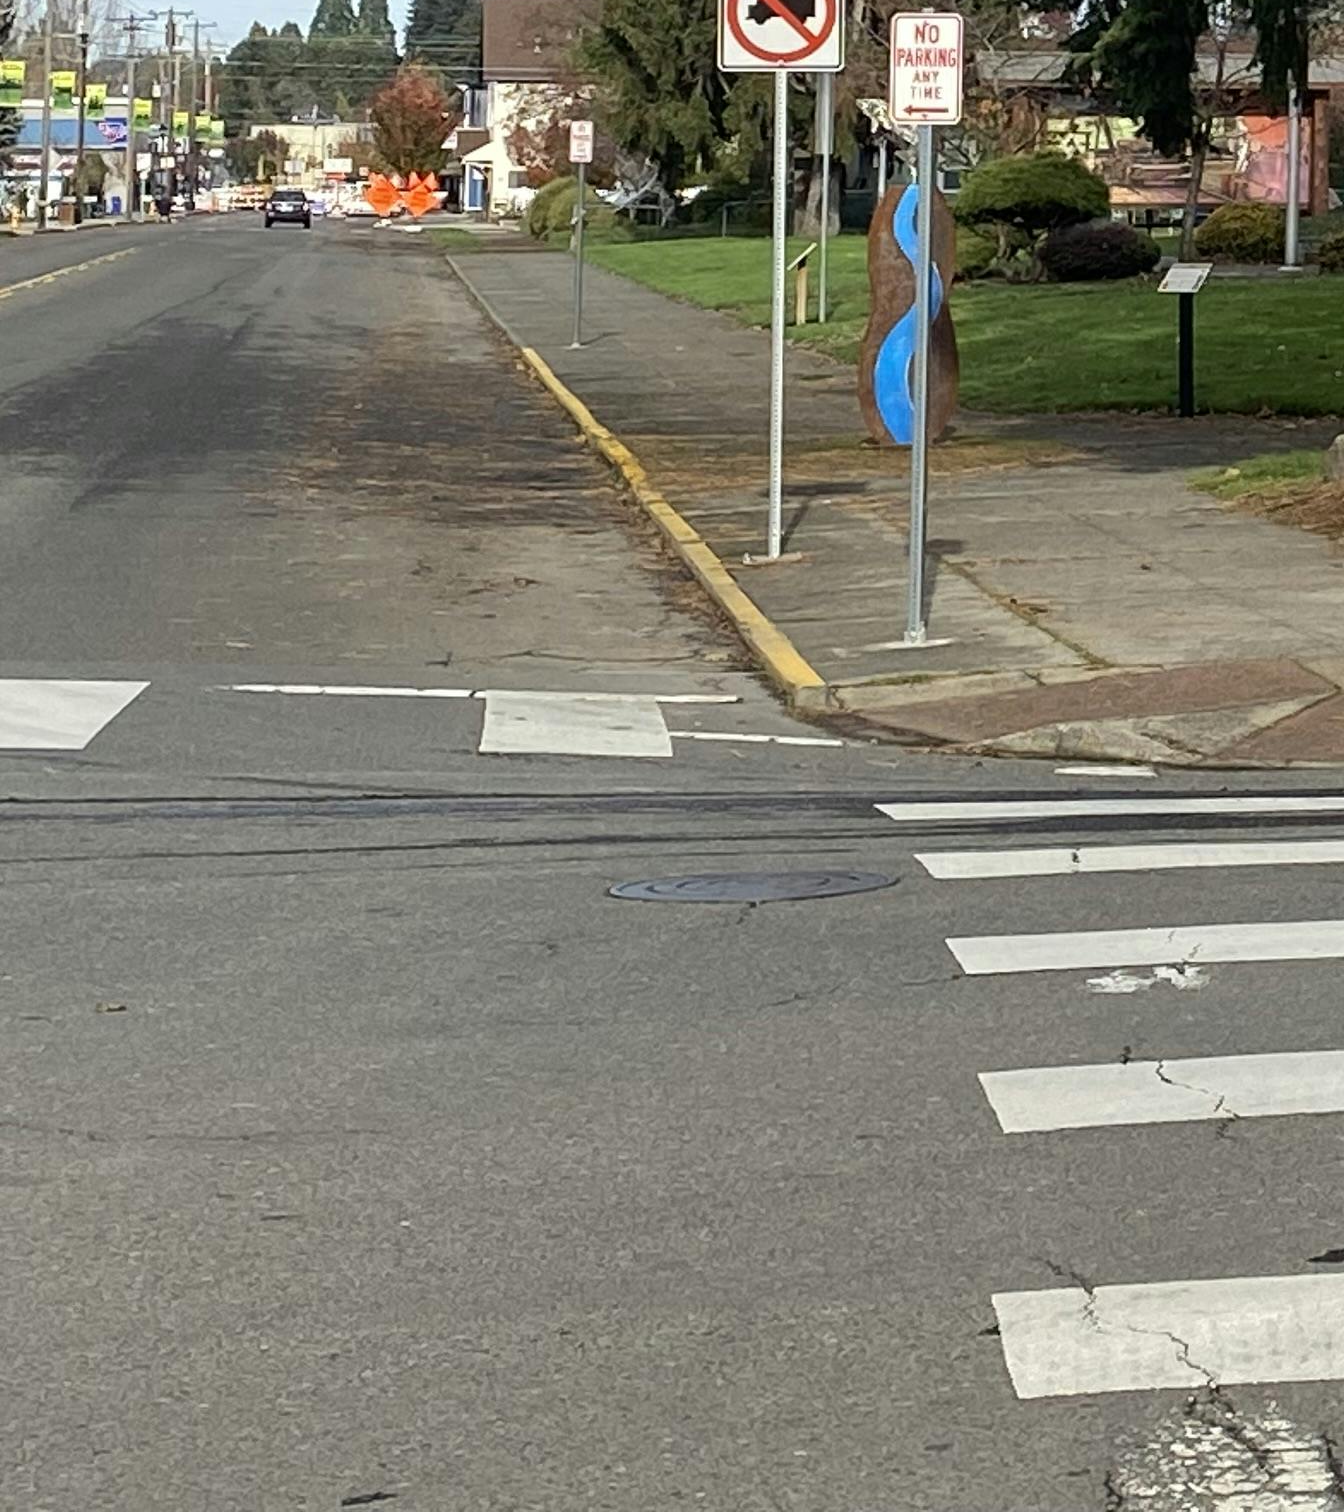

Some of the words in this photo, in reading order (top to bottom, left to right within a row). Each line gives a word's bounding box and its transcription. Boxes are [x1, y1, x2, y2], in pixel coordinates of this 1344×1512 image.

[914, 23, 940, 44] NO
[896, 48, 957, 67] PARKING
[912, 70, 939, 83] ANY
[910, 86, 943, 99] TIME
